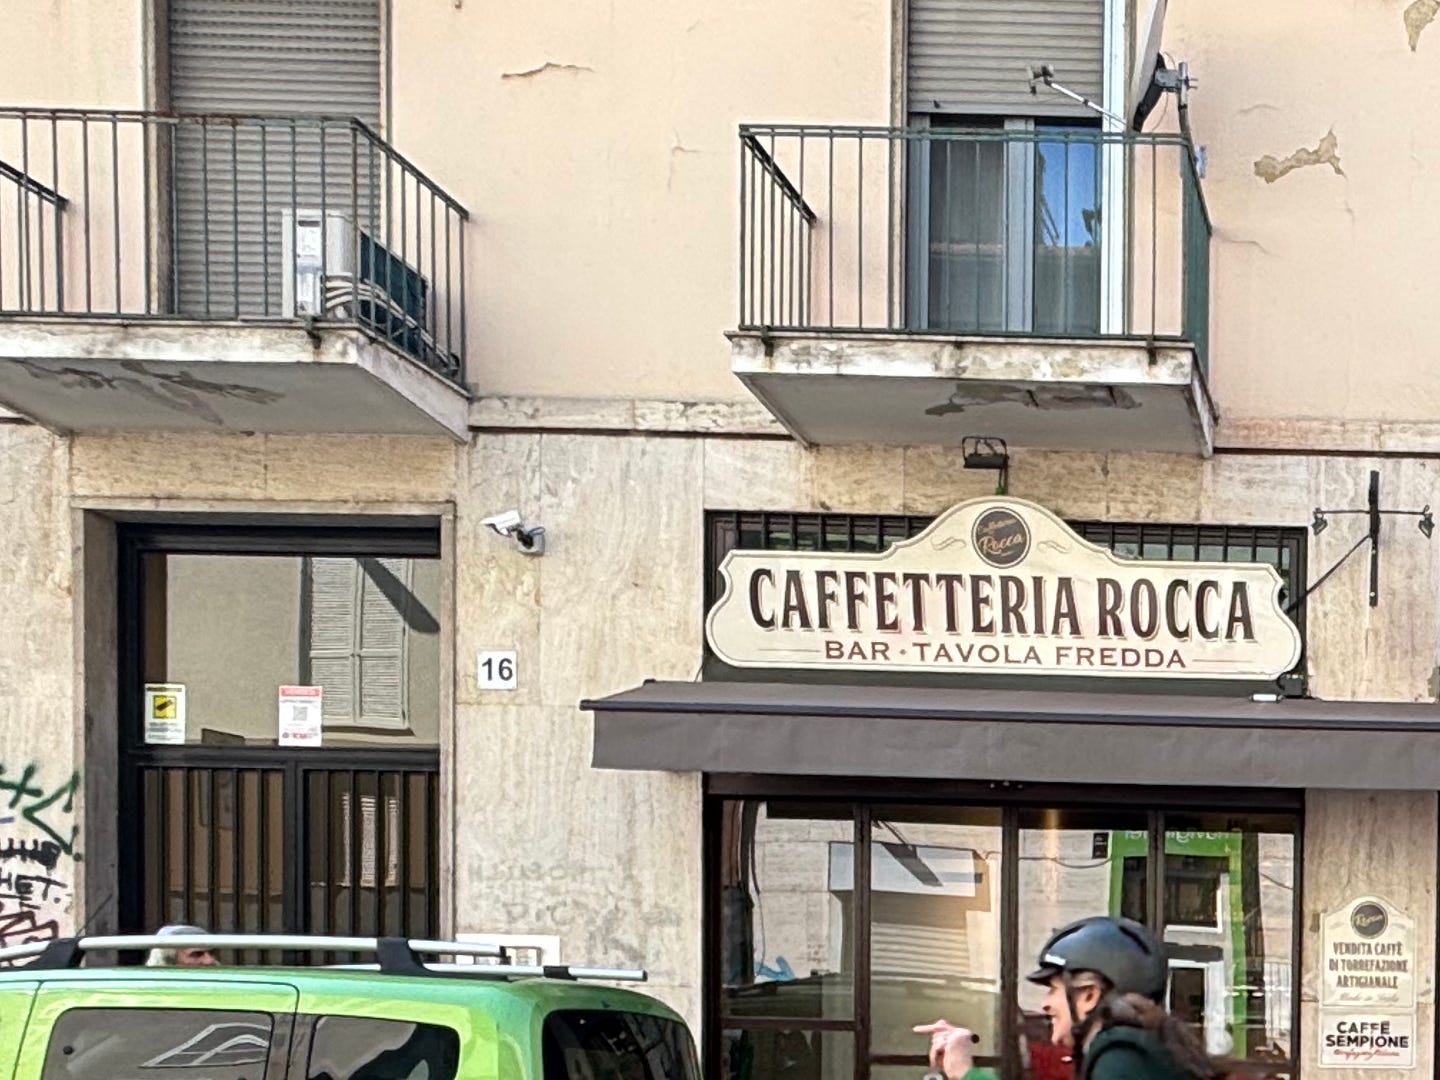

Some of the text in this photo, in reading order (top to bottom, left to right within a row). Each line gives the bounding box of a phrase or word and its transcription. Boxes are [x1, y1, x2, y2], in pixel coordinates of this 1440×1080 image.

[750, 568, 1256, 642] CAFFETTERIA ROCCA
[825, 640, 1186, 669] BAR TAVOLA FREDDA
[482, 657, 513, 681] 16
[1326, 1034, 1409, 1048] SEMPIONE
